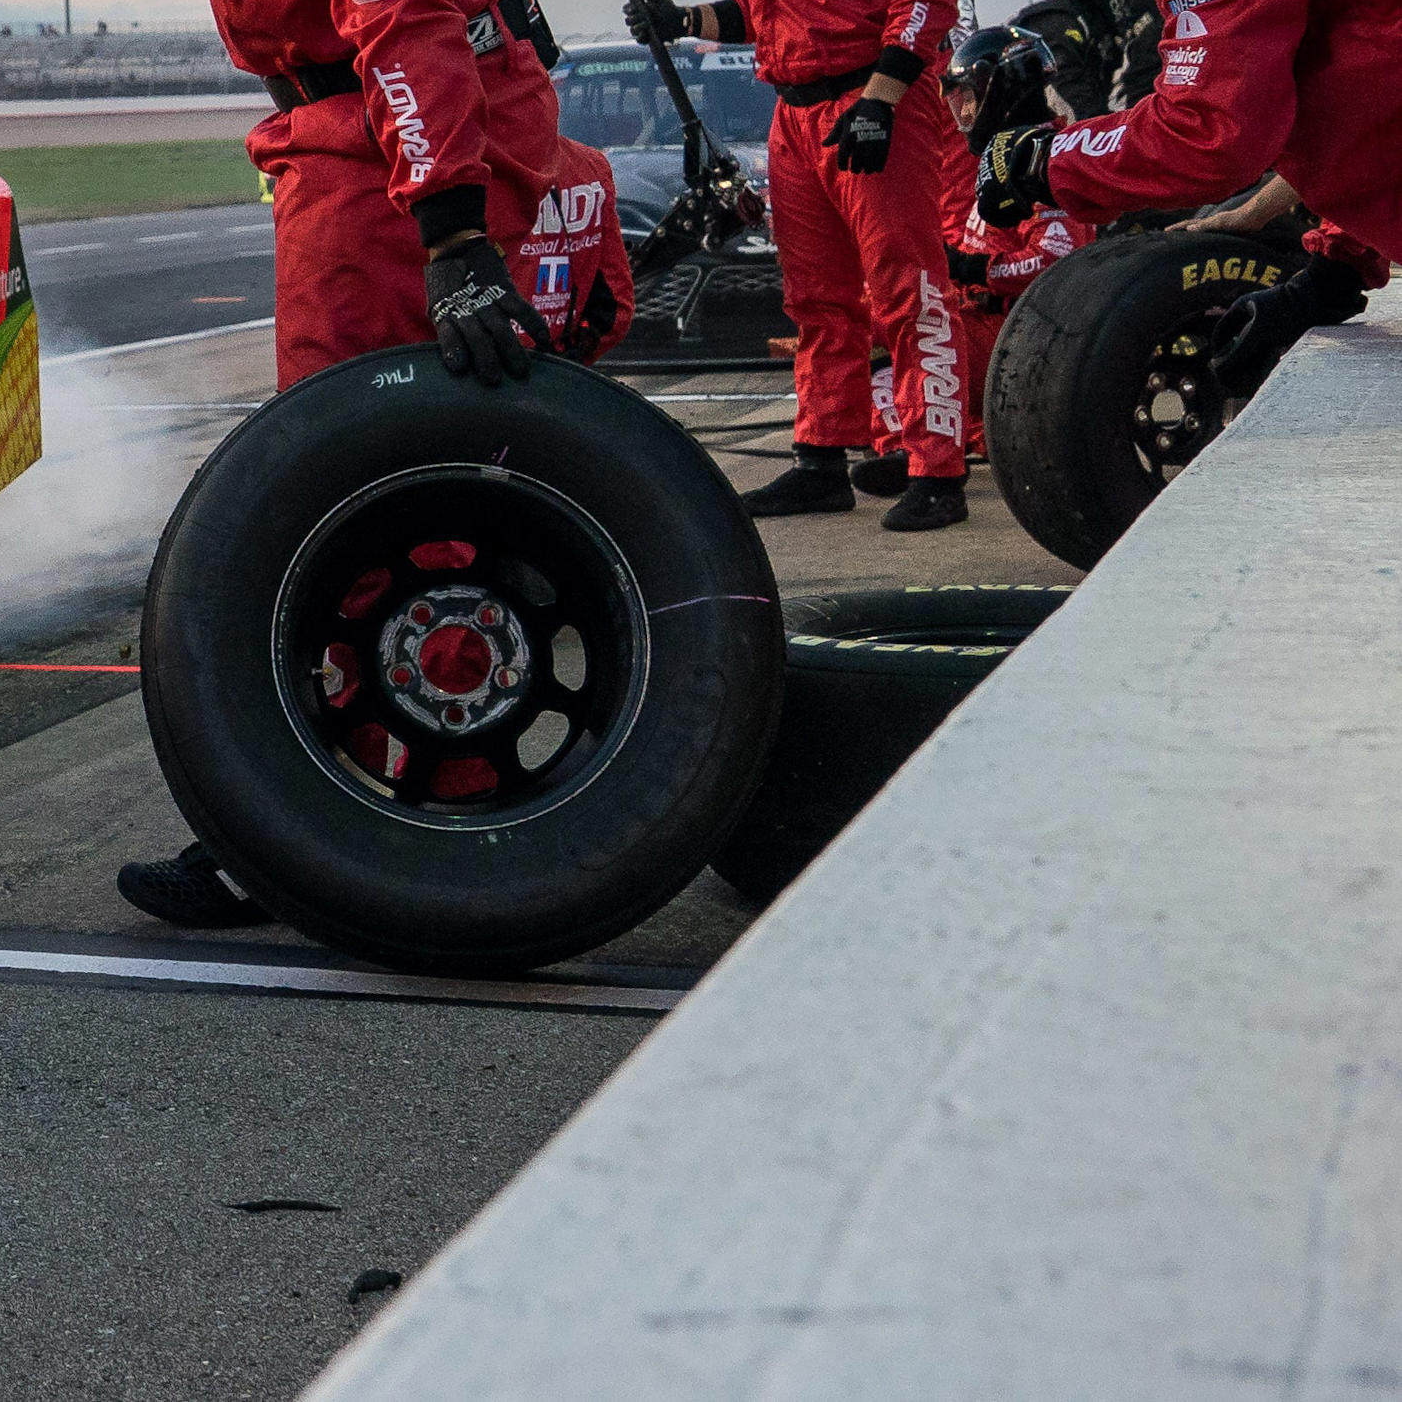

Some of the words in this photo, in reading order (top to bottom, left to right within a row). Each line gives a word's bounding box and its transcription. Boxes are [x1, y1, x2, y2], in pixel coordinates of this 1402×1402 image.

[372, 66, 435, 183] BRANDT
[990, 256, 1045, 279] BRANDT
[1182, 257, 1282, 291] EAGLE
[451, 284, 507, 319] Mechanix
[915, 270, 963, 447] BRANDT
